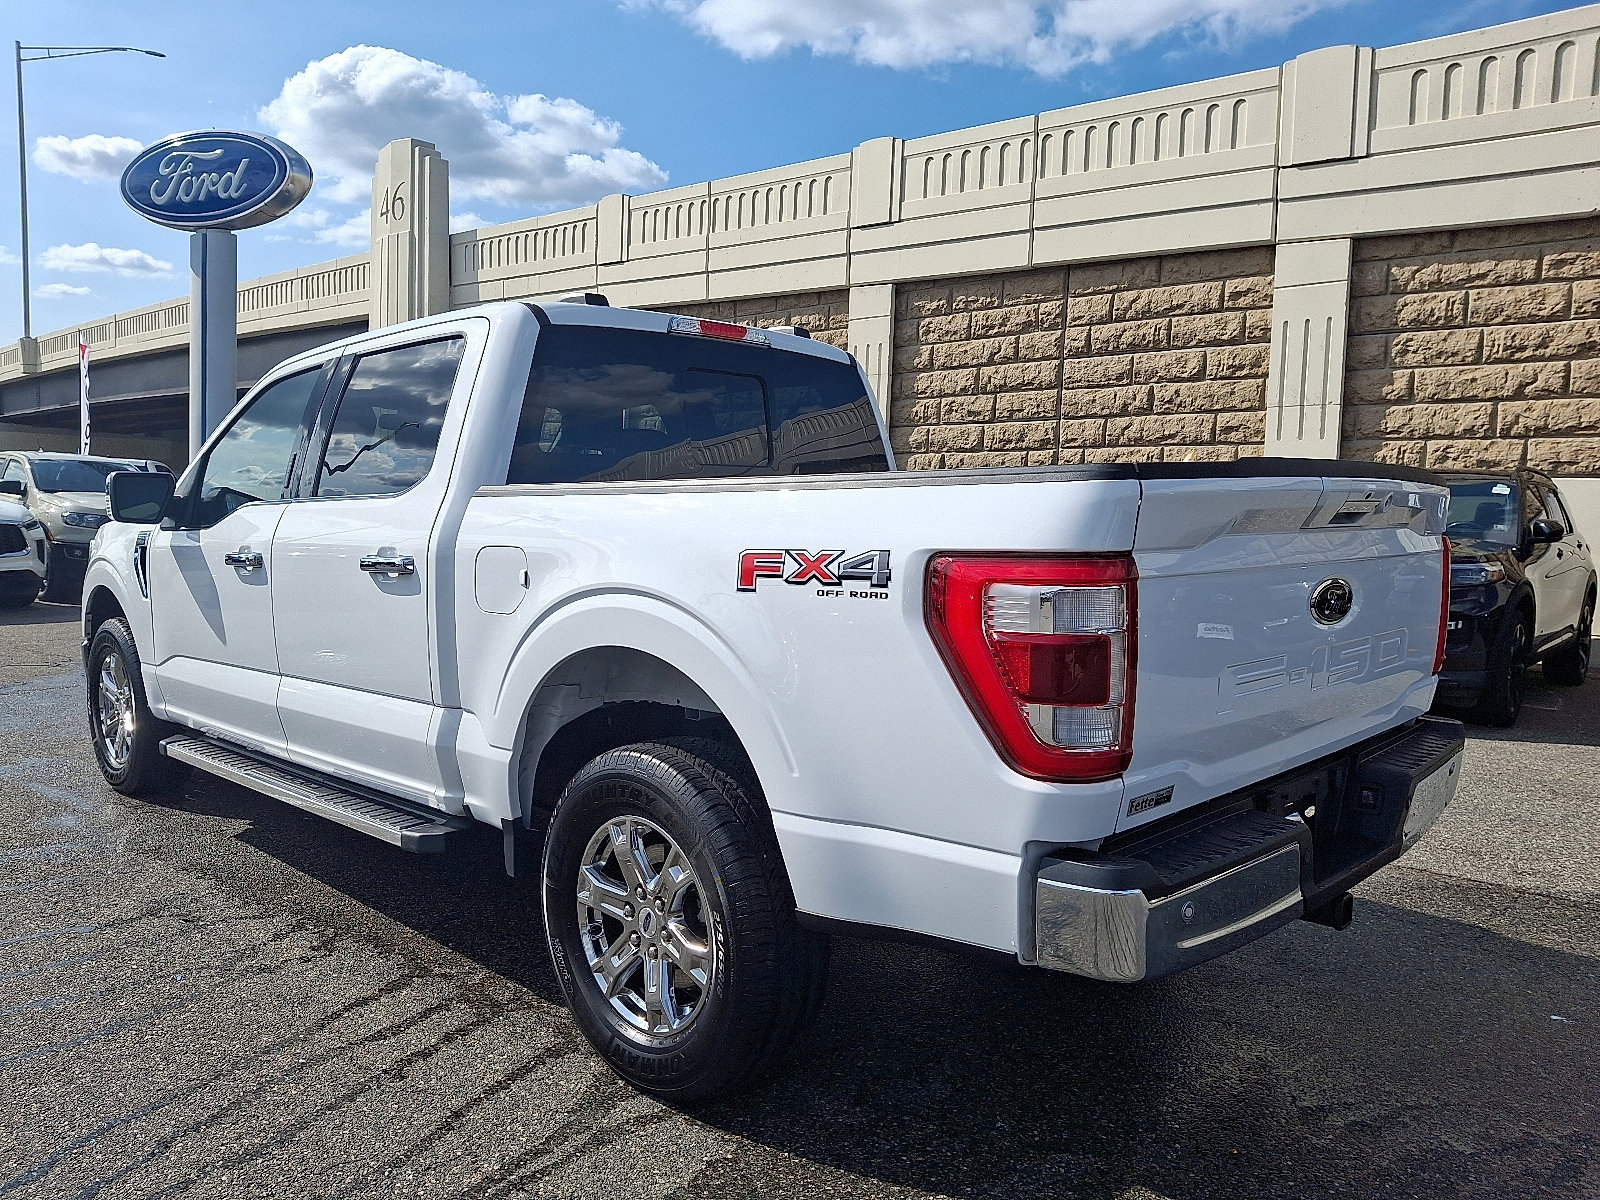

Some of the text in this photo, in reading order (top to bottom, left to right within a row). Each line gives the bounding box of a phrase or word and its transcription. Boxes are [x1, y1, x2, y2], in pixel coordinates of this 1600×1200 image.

[150, 149, 249, 205] Ford
[380, 181, 405, 224] 46
[736, 549, 891, 592] FX4
[816, 589, 888, 600] OFF ROAD
[1216, 628, 1408, 716] F-150
